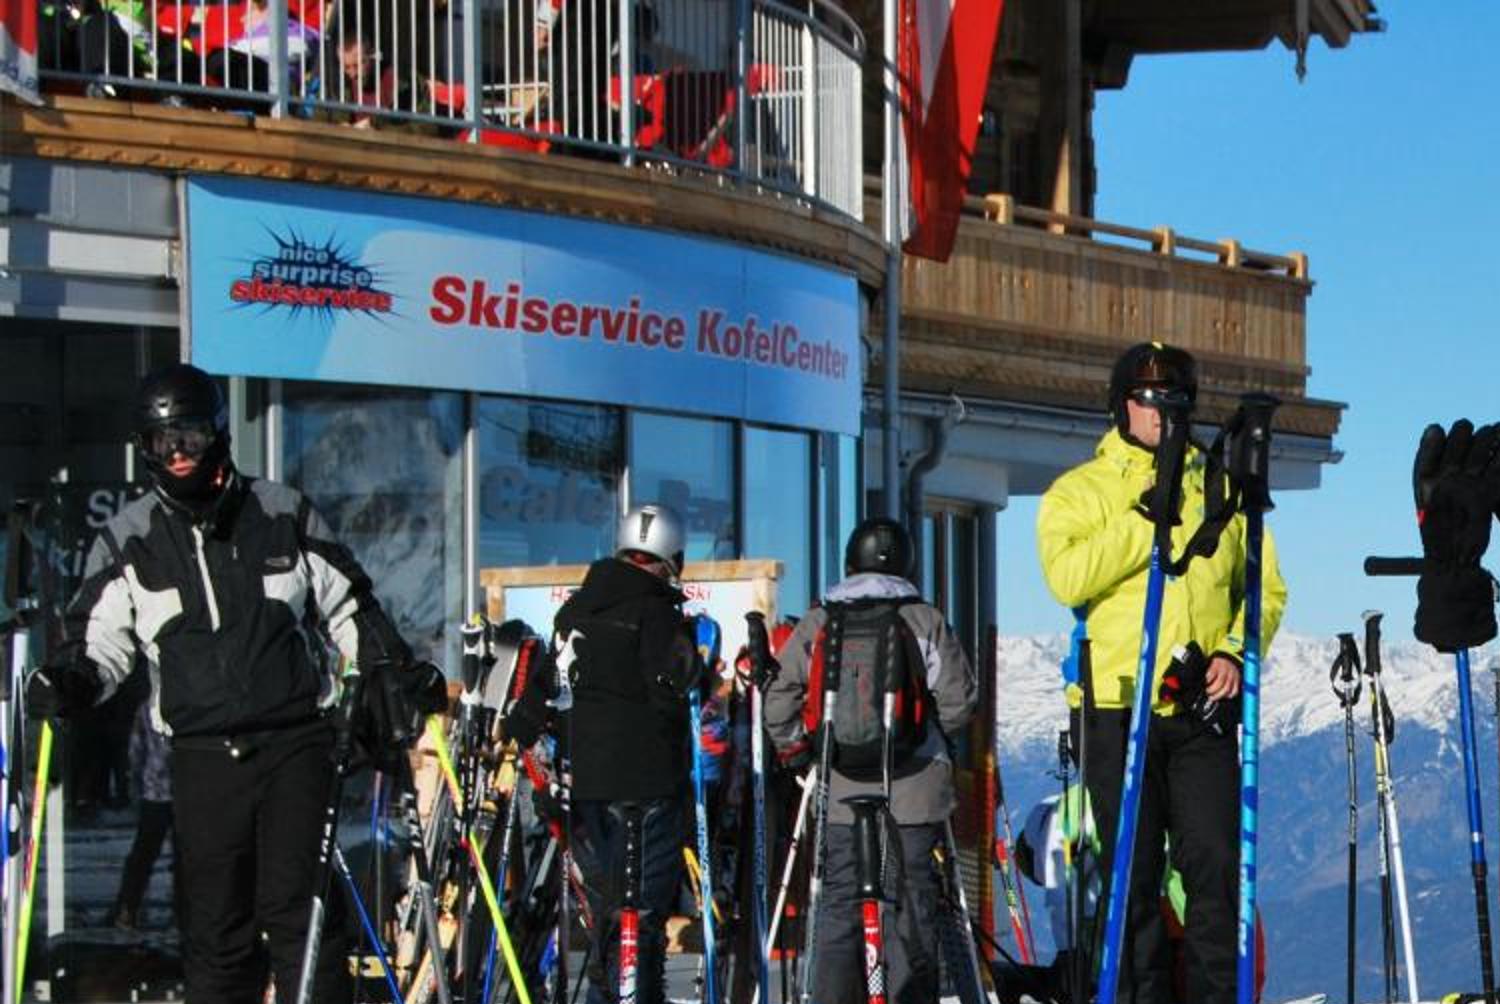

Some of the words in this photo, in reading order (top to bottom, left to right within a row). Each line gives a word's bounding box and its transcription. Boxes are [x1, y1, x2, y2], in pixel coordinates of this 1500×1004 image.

[279, 246, 329, 263] nice
[254, 261, 373, 288] surprise
[230, 278, 393, 312] skiservice
[429, 276, 686, 349] Skiservice
[697, 309, 849, 379] KofelCenter
